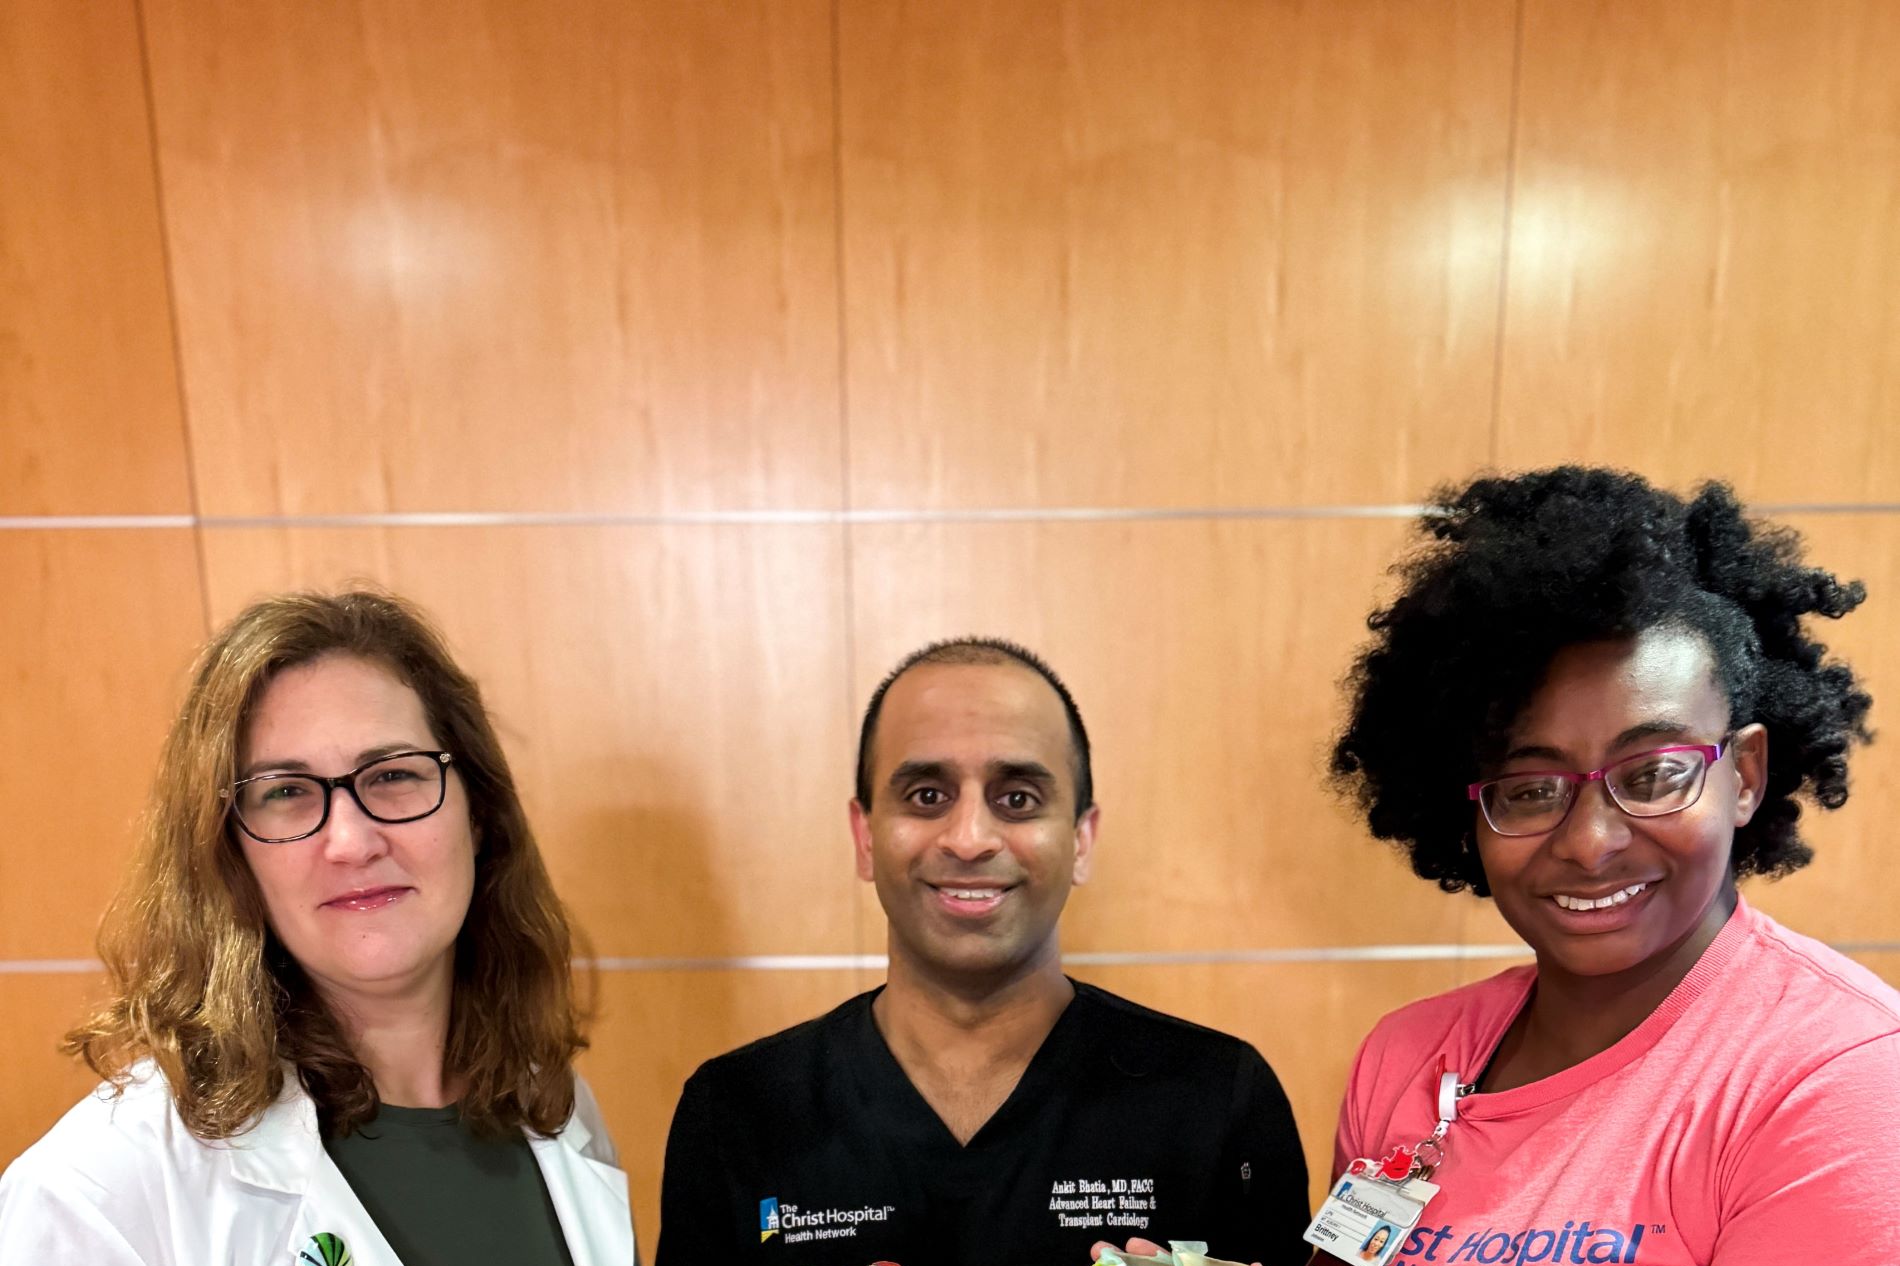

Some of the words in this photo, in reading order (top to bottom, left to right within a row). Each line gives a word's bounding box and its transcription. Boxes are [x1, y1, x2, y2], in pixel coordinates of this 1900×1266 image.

[1051, 1181, 1076, 1194] Ankit
[1131, 1179, 1154, 1193] FACC
[779, 1204, 798, 1214] The
[1049, 1196, 1089, 1210] Advanced
[1092, 1195, 1115, 1209] Heart
[1119, 1195, 1148, 1209] Failure
[1149, 1196, 1156, 1209] &
[1346, 1194, 1363, 1208] Christ
[1363, 1201, 1387, 1218] Hospital
[781, 1210, 825, 1229] Christ
[826, 1205, 887, 1225] Hospital
[1058, 1213, 1103, 1229] Transplant
[1106, 1212, 1149, 1229] Cardiology
[784, 1230, 814, 1244] Health
[815, 1226, 857, 1240] Network
[1314, 1223, 1339, 1242] Brittney
